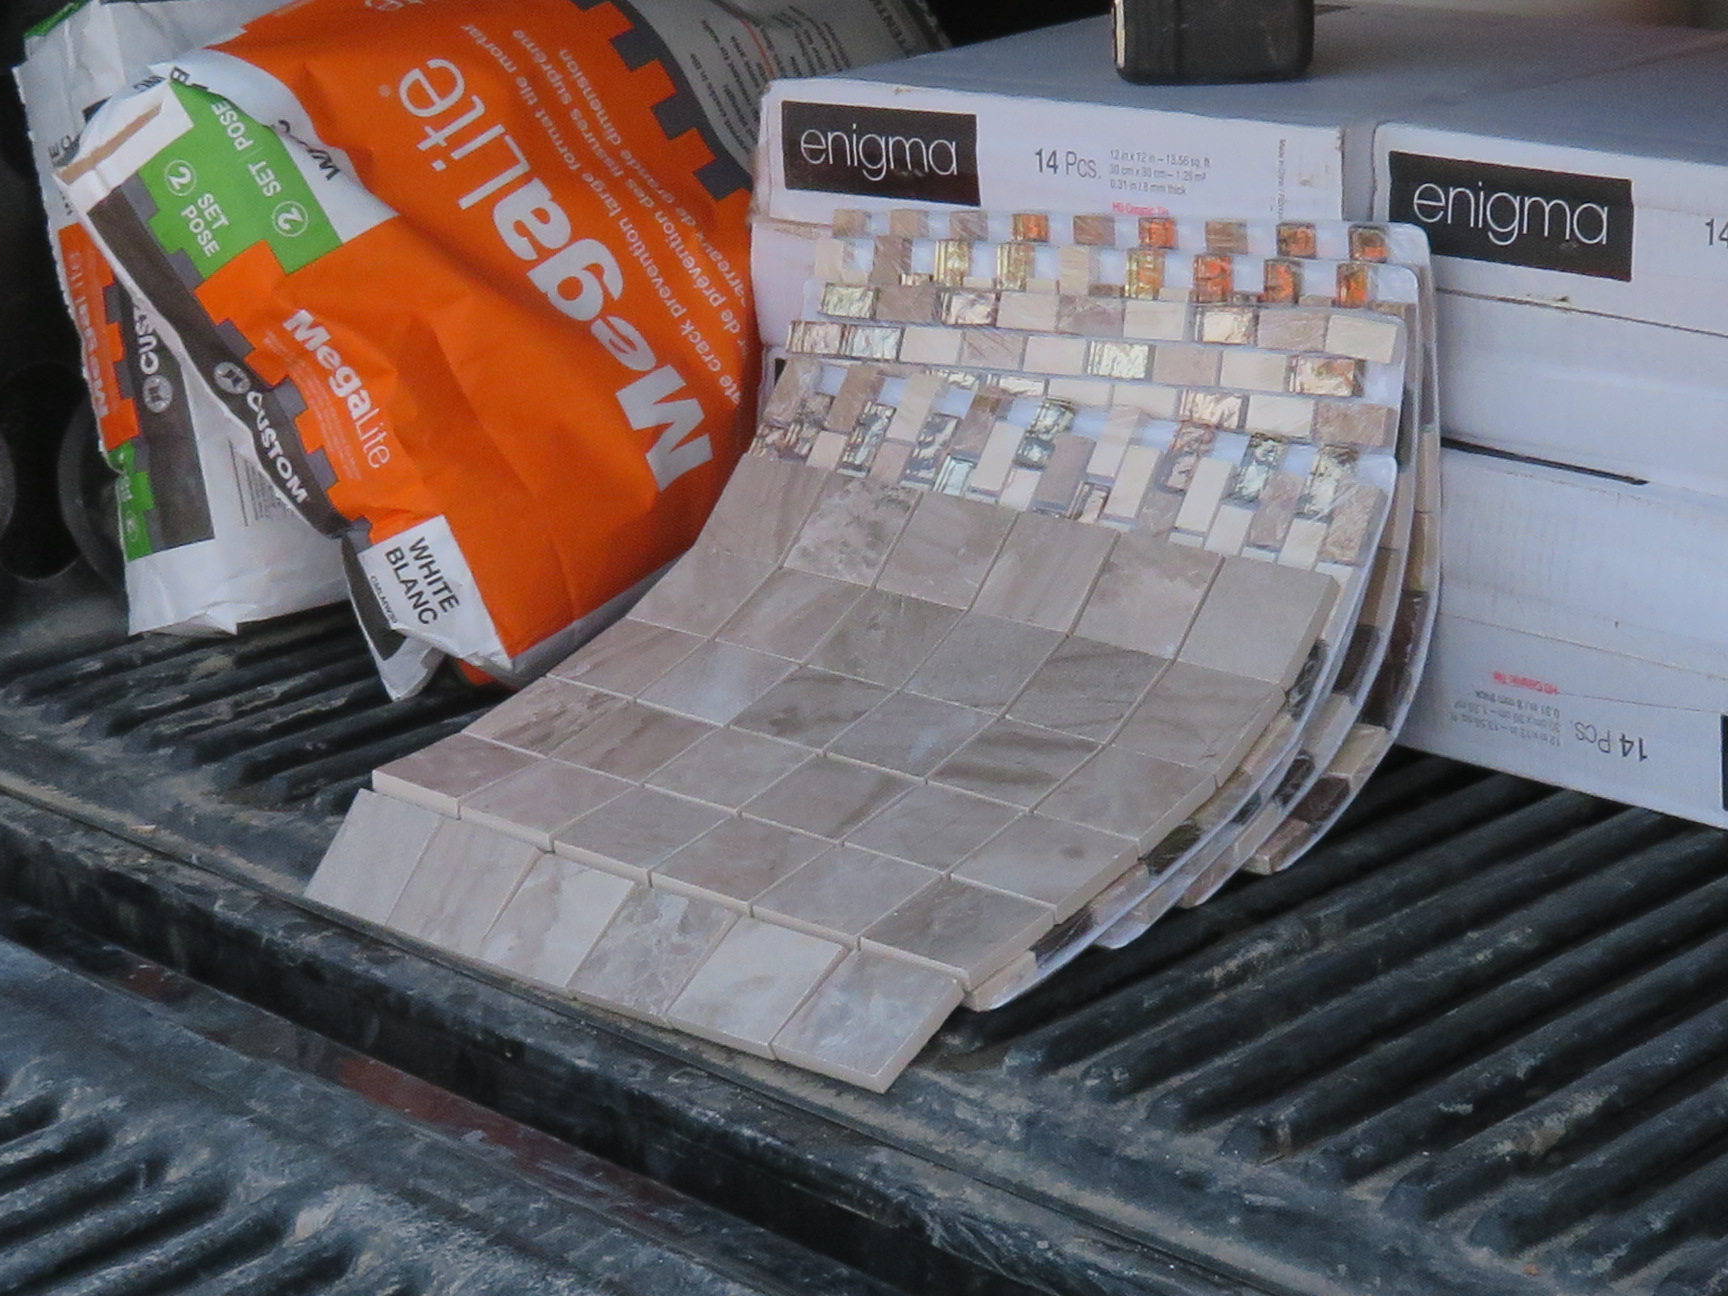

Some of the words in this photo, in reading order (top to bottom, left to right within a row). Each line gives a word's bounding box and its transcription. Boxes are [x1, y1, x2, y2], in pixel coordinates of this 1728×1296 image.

[461, 24, 518, 73] mortar
[512, 29, 572, 104] suprême
[515, 76, 538, 105] tile
[560, 49, 622, 146] dimension
[211, 101, 255, 151] POSE
[534, 107, 582, 170] format
[570, 108, 624, 177] fissures
[800, 123, 958, 181] enigma
[247, 159, 282, 197] SET
[1034, 148, 1060, 175] 14
[1065, 150, 1102, 180] Pcs.
[197, 192, 230, 231] SET
[581, 172, 622, 217] large
[625, 178, 655, 208] des
[675, 207, 696, 227] de
[1413, 181, 1608, 246] enigma
[180, 204, 220, 258] POSE
[654, 209, 727, 308] prévention
[398, 58, 713, 492] MegaLite
[619, 216, 688, 318] prevention
[681, 319, 721, 372] crack
[721, 308, 742, 334] de
[282, 309, 391, 468] MegaLite
[246, 390, 309, 503] CUSTOM
[385, 546, 438, 625] BLANC
[409, 536, 460, 613] WHITE
[1619, 732, 1648, 762] 14
